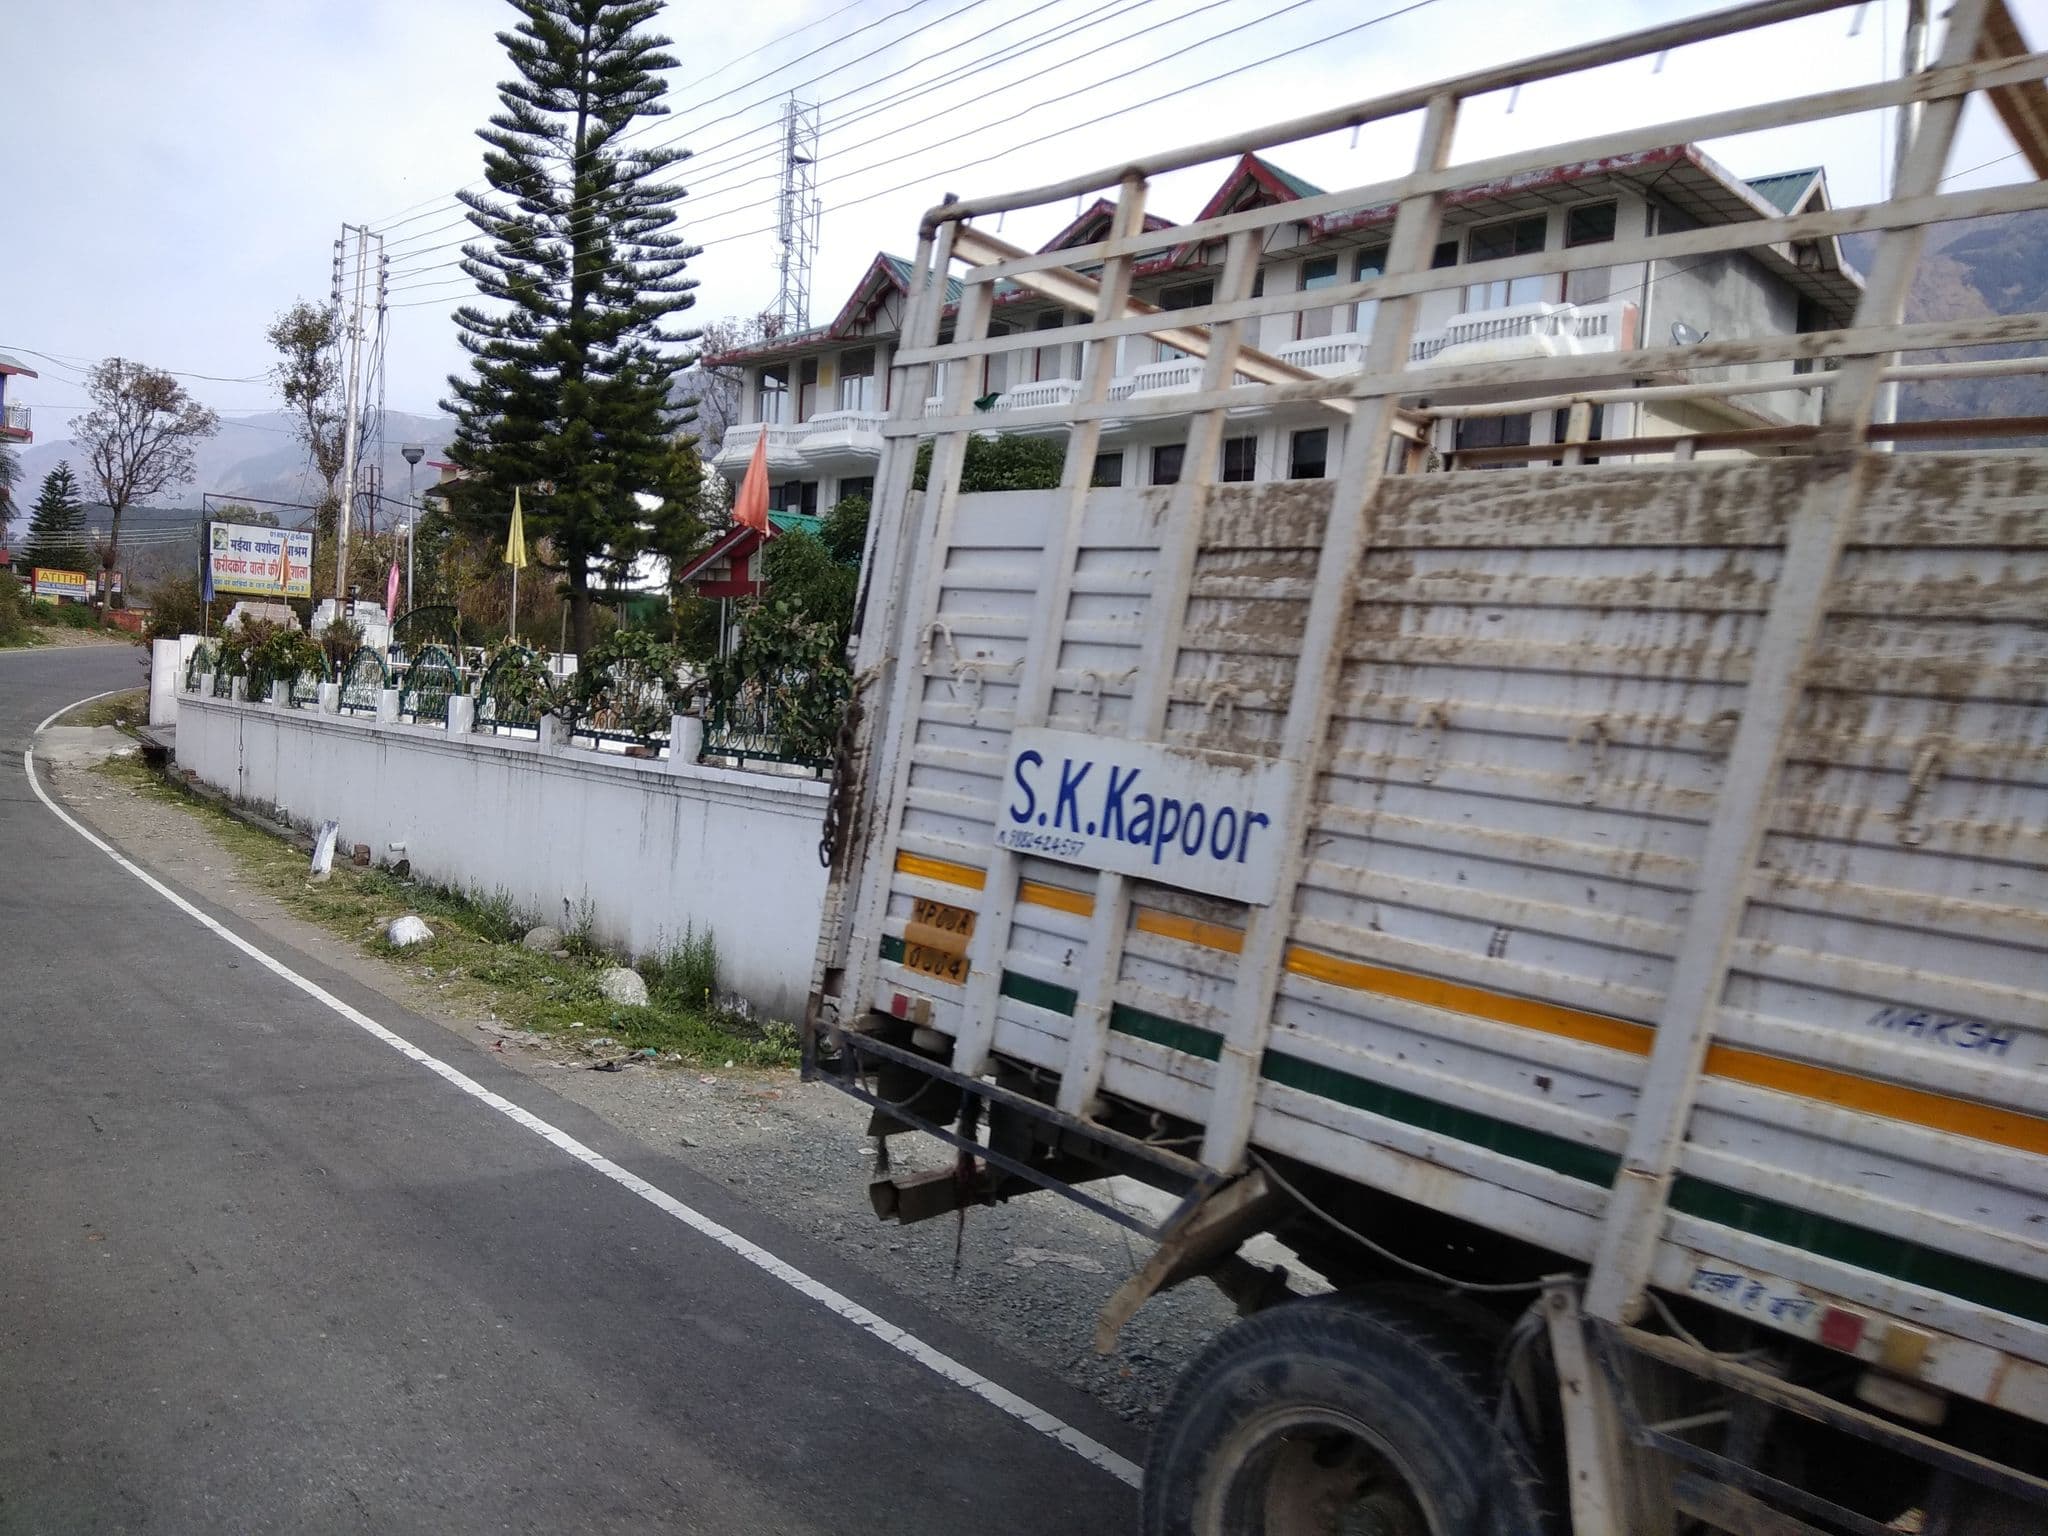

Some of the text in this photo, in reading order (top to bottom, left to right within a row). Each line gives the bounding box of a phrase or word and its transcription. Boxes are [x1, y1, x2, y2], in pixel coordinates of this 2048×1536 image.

[255, 540, 280, 556] यशोदा
[214, 554, 247, 574] फरीदकोट
[41, 572, 82, 585] ATITHI
[1010, 749, 1270, 864] S.K.Kapoor
